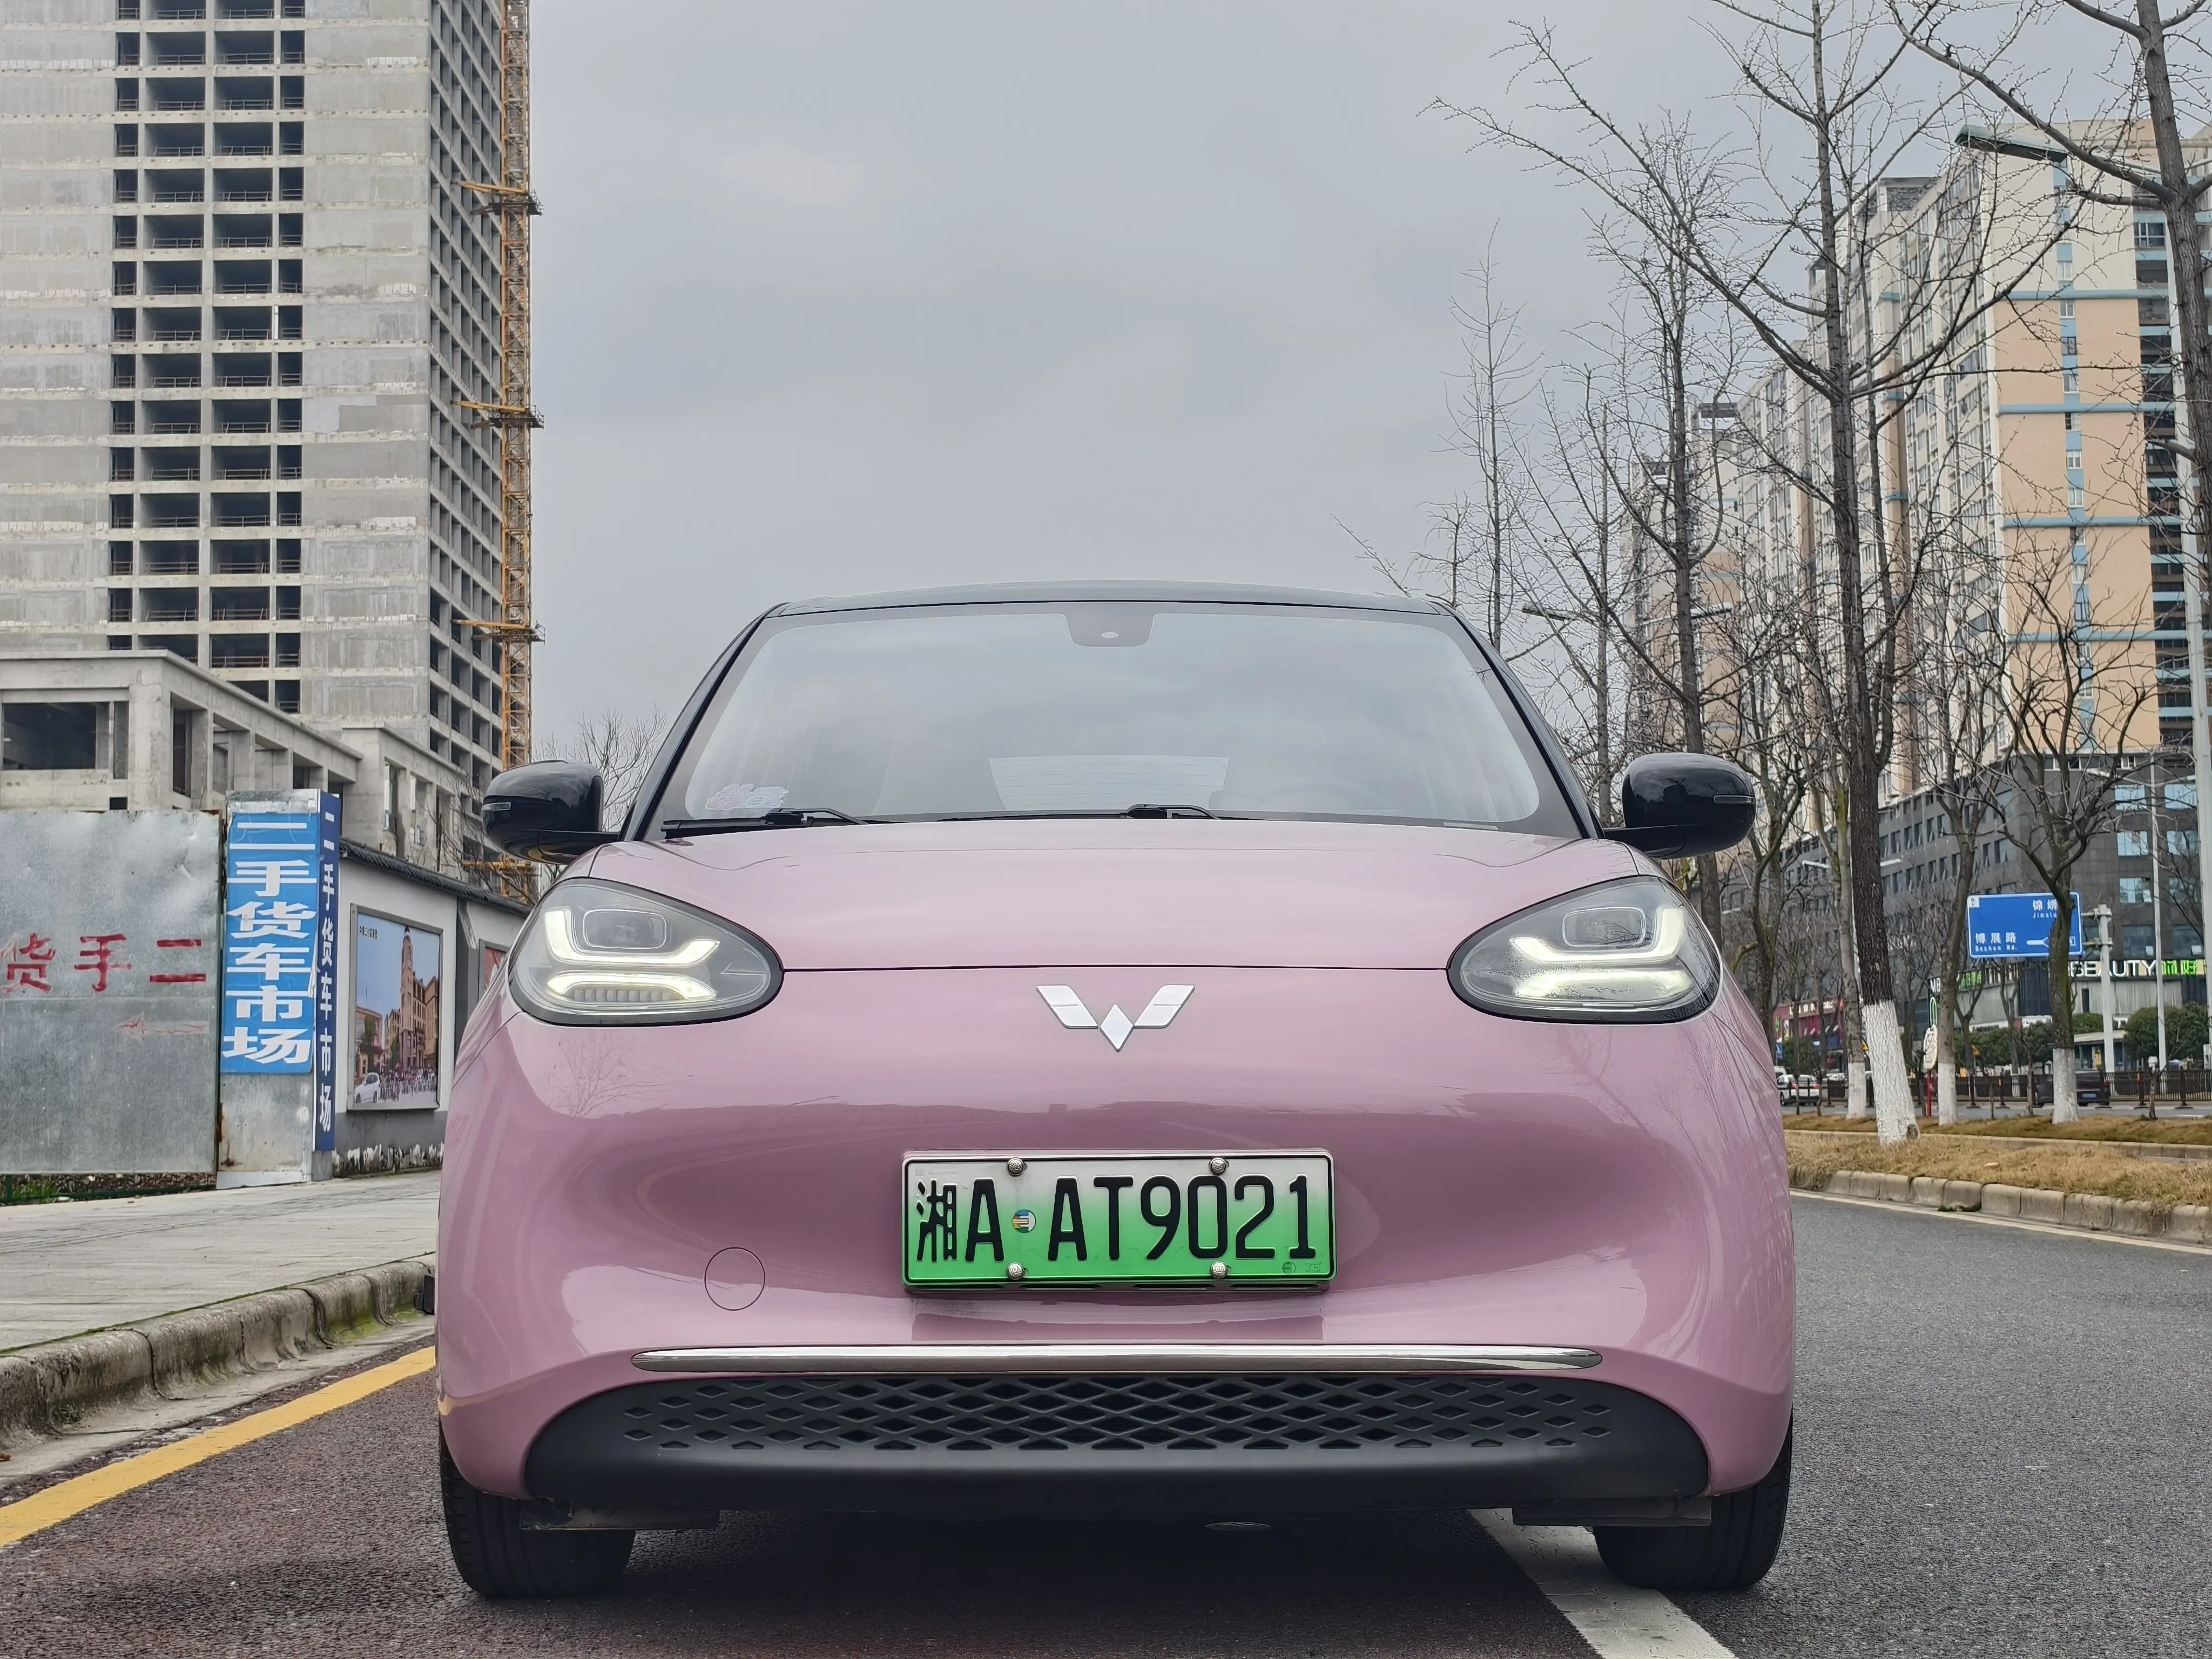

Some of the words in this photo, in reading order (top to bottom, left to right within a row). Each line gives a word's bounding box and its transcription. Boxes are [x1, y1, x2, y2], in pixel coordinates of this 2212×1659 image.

[222, 821, 318, 1064] 二手货车市场
[319, 811, 335, 1133] 二手货车市场
[916, 1177, 1005, 1263] 湘A
[1048, 1175, 1317, 1261] AT9021
